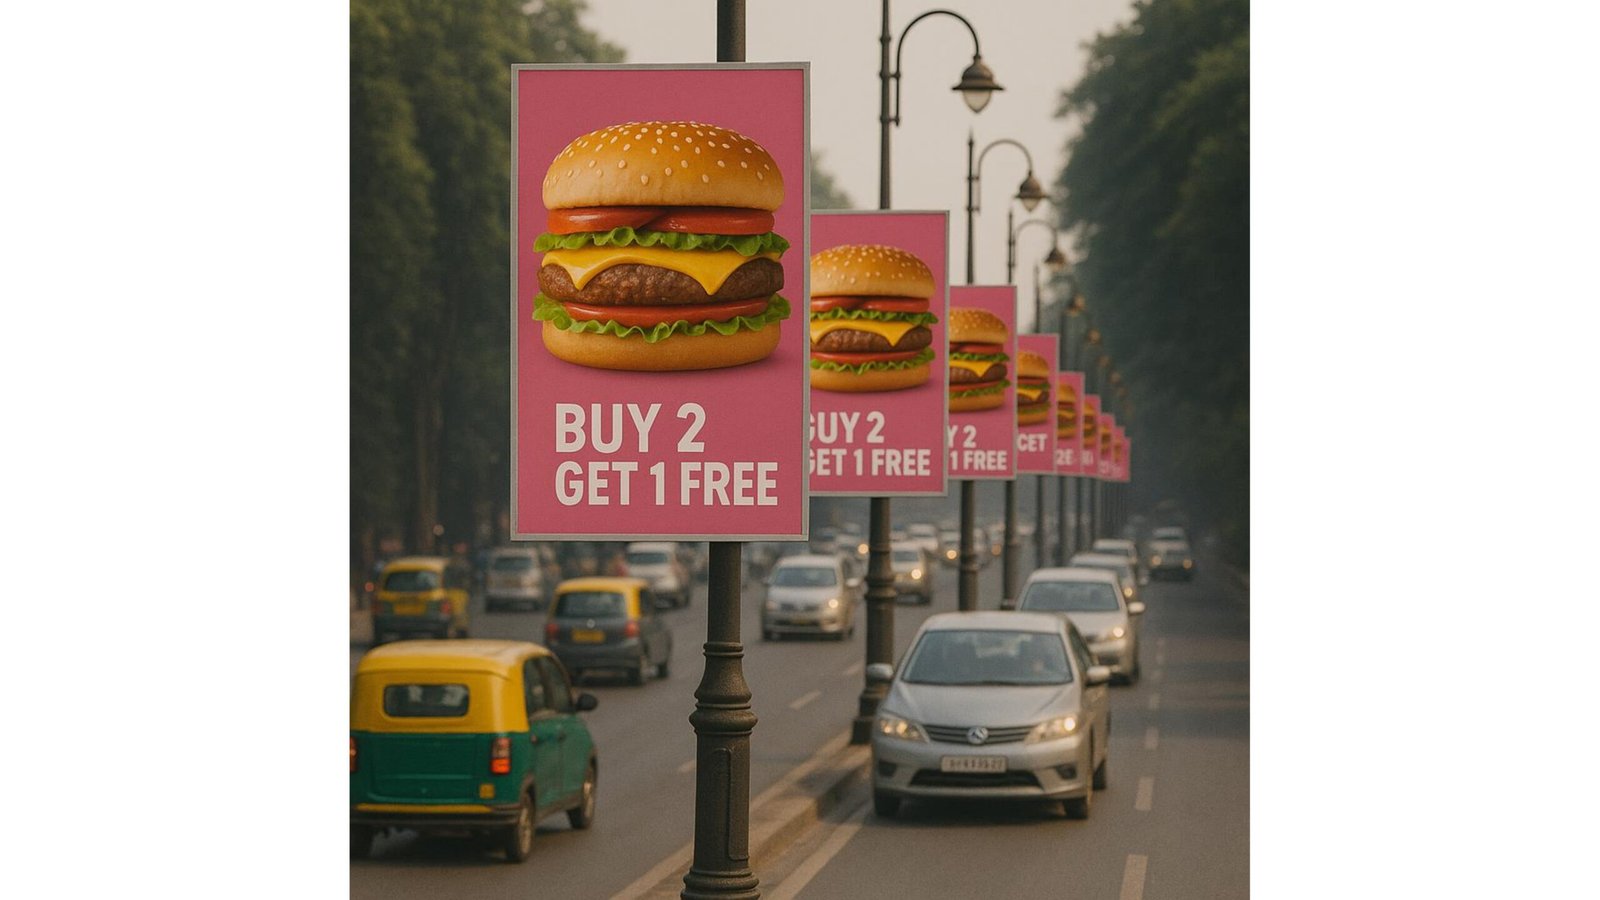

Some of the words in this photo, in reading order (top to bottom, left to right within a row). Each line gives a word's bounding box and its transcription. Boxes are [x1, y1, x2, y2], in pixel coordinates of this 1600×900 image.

[555, 403, 662, 453] BUY
[676, 402, 706, 453] 2
[866, 411, 885, 443] 2
[963, 424, 977, 448] 2
[853, 448, 863, 476] 1
[871, 448, 931, 476] FREE
[950, 450, 959, 470] 1
[963, 450, 1008, 470] FREE
[555, 460, 639, 506] GET
[649, 461, 665, 505] 1
[680, 461, 779, 506] FREE
